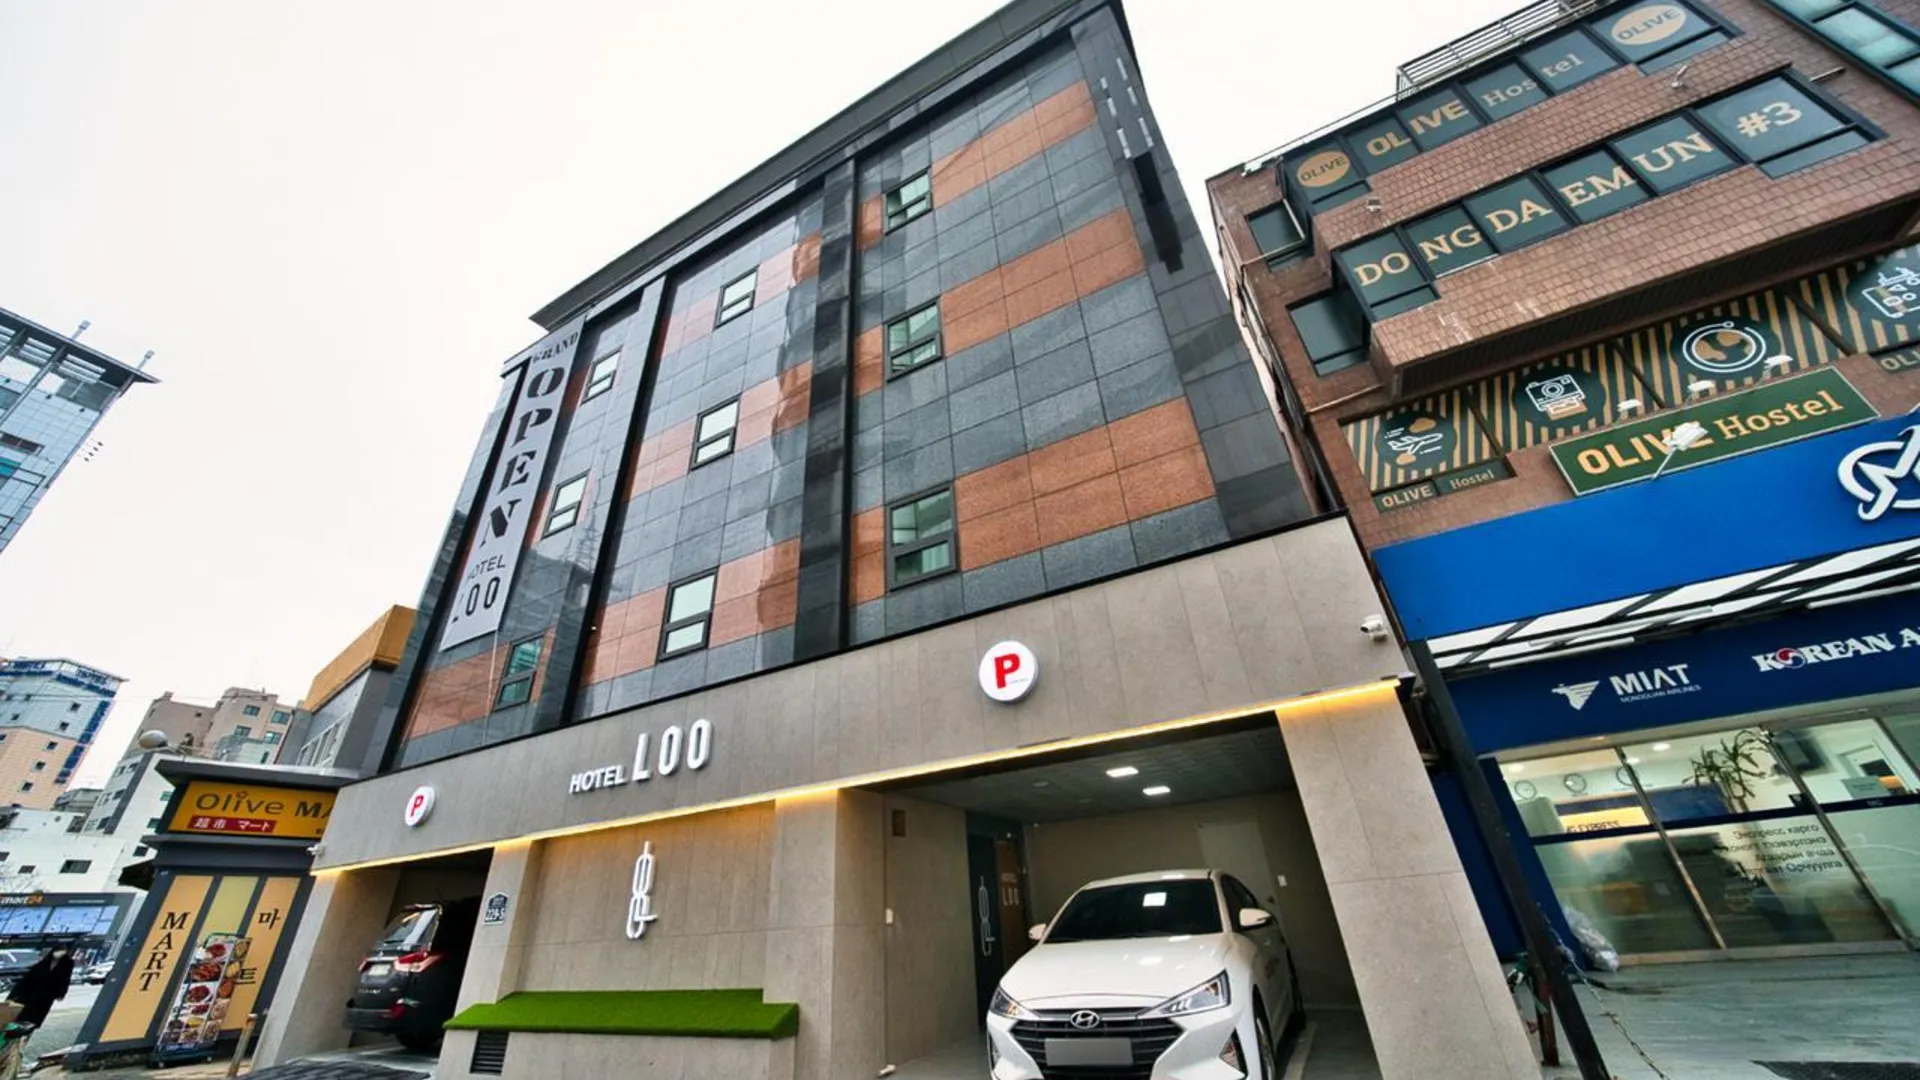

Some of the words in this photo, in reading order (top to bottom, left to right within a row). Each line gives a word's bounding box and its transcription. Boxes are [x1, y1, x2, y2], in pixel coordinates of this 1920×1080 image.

[1617, 8, 1681, 40] OLIVE
[1736, 100, 1804, 139] #3
[1300, 155, 1345, 182] OLIVE
[1713, 390, 1844, 440] Hostel
[480, 366, 565, 547] OPEN
[1381, 485, 1434, 508] OLIVE
[1448, 468, 1495, 490] Hostel
[467, 554, 506, 580] OTEL
[994, 653, 1021, 689] P
[1751, 632, 1897, 673] KOREAN
[1609, 663, 1691, 696] MIAT
[569, 763, 628, 794] HOTEL
[631, 718, 713, 782] LOO
[196, 790, 285, 816] Olive
[411, 795, 425, 818] P
[139, 911, 190, 992] MART
